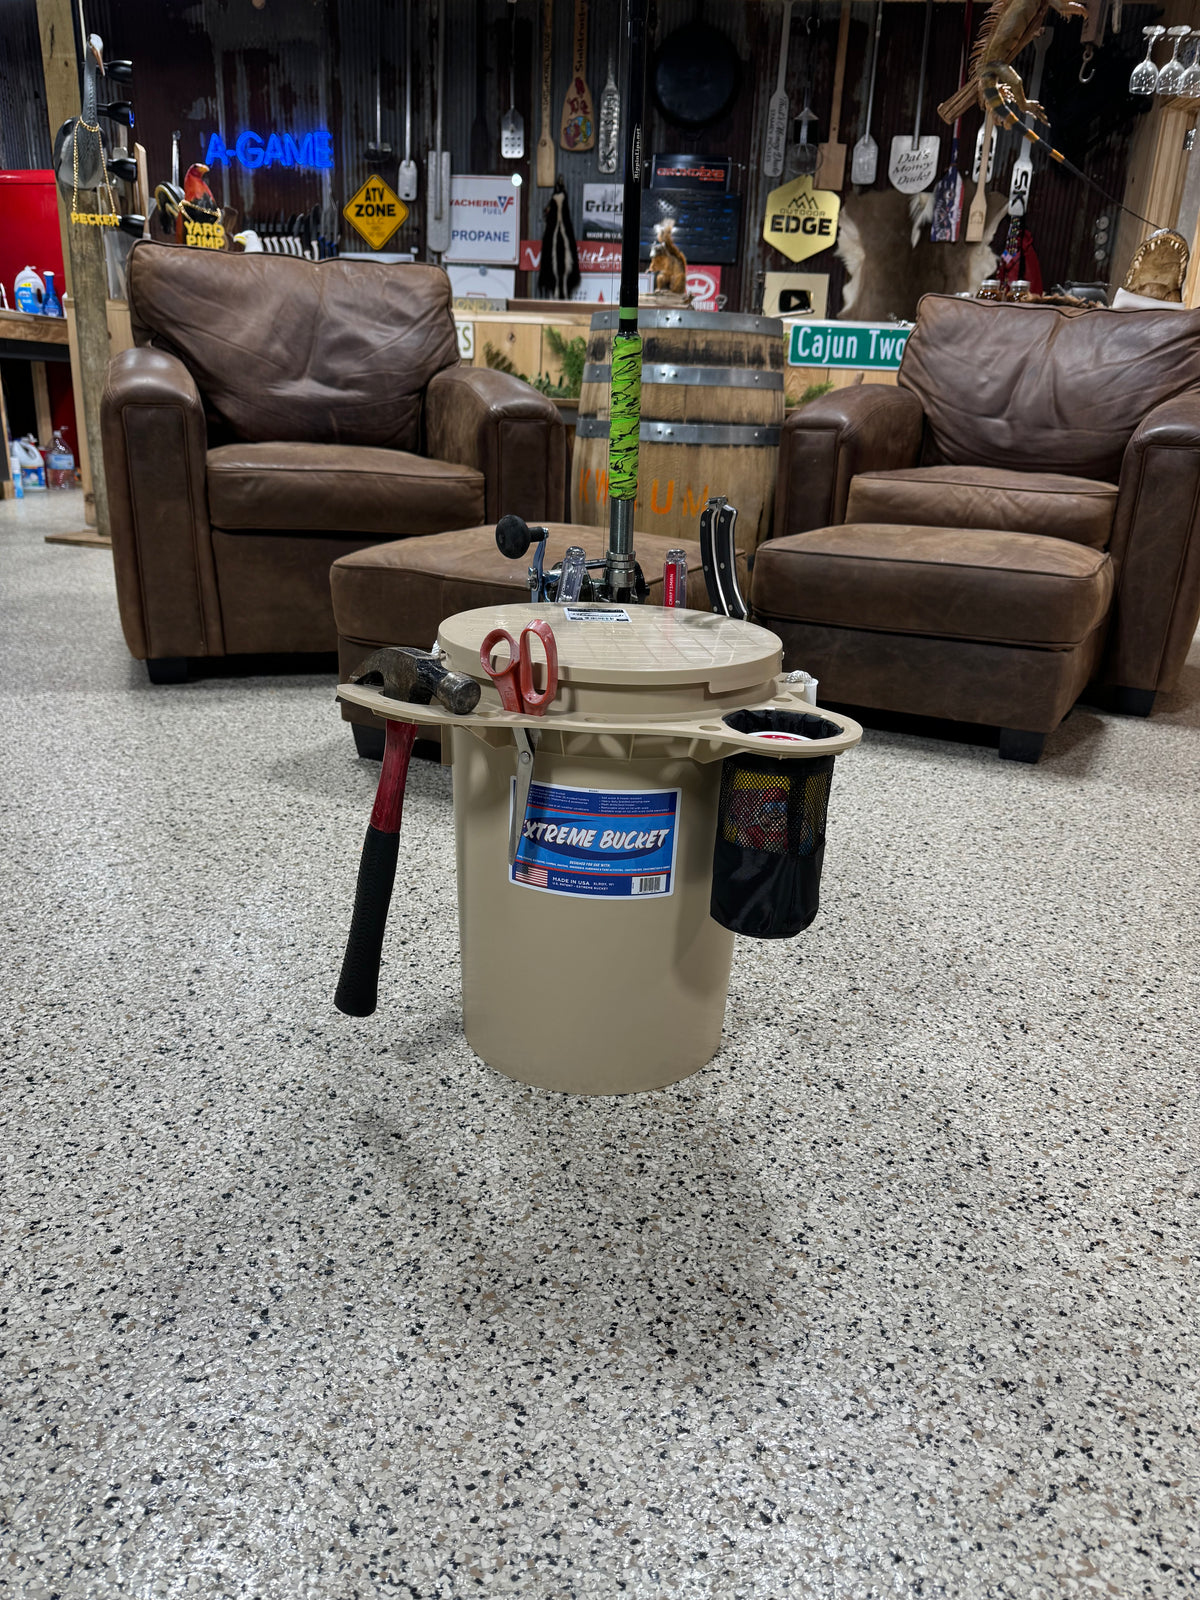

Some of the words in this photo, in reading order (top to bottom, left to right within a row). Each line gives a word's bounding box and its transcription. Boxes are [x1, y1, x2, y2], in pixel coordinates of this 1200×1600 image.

[205, 131, 334, 168] A-GAME
[365, 188, 384, 202] ATV
[355, 204, 396, 217] ZONE
[483, 207, 502, 215] FUEL
[780, 208, 826, 217] OUTDOOR
[71, 211, 120, 227] PECKER
[770, 215, 832, 236] EDGE
[184, 221, 225, 237] YARD
[451, 230, 510, 242] PROPANE
[186, 235, 225, 249] PIMP
[797, 327, 858, 364] Cajun
[868, 330, 908, 361] Two
[523, 819, 597, 848] XTREME
[600, 829, 671, 850] BUCKET
[552, 876, 569, 884] MADE
